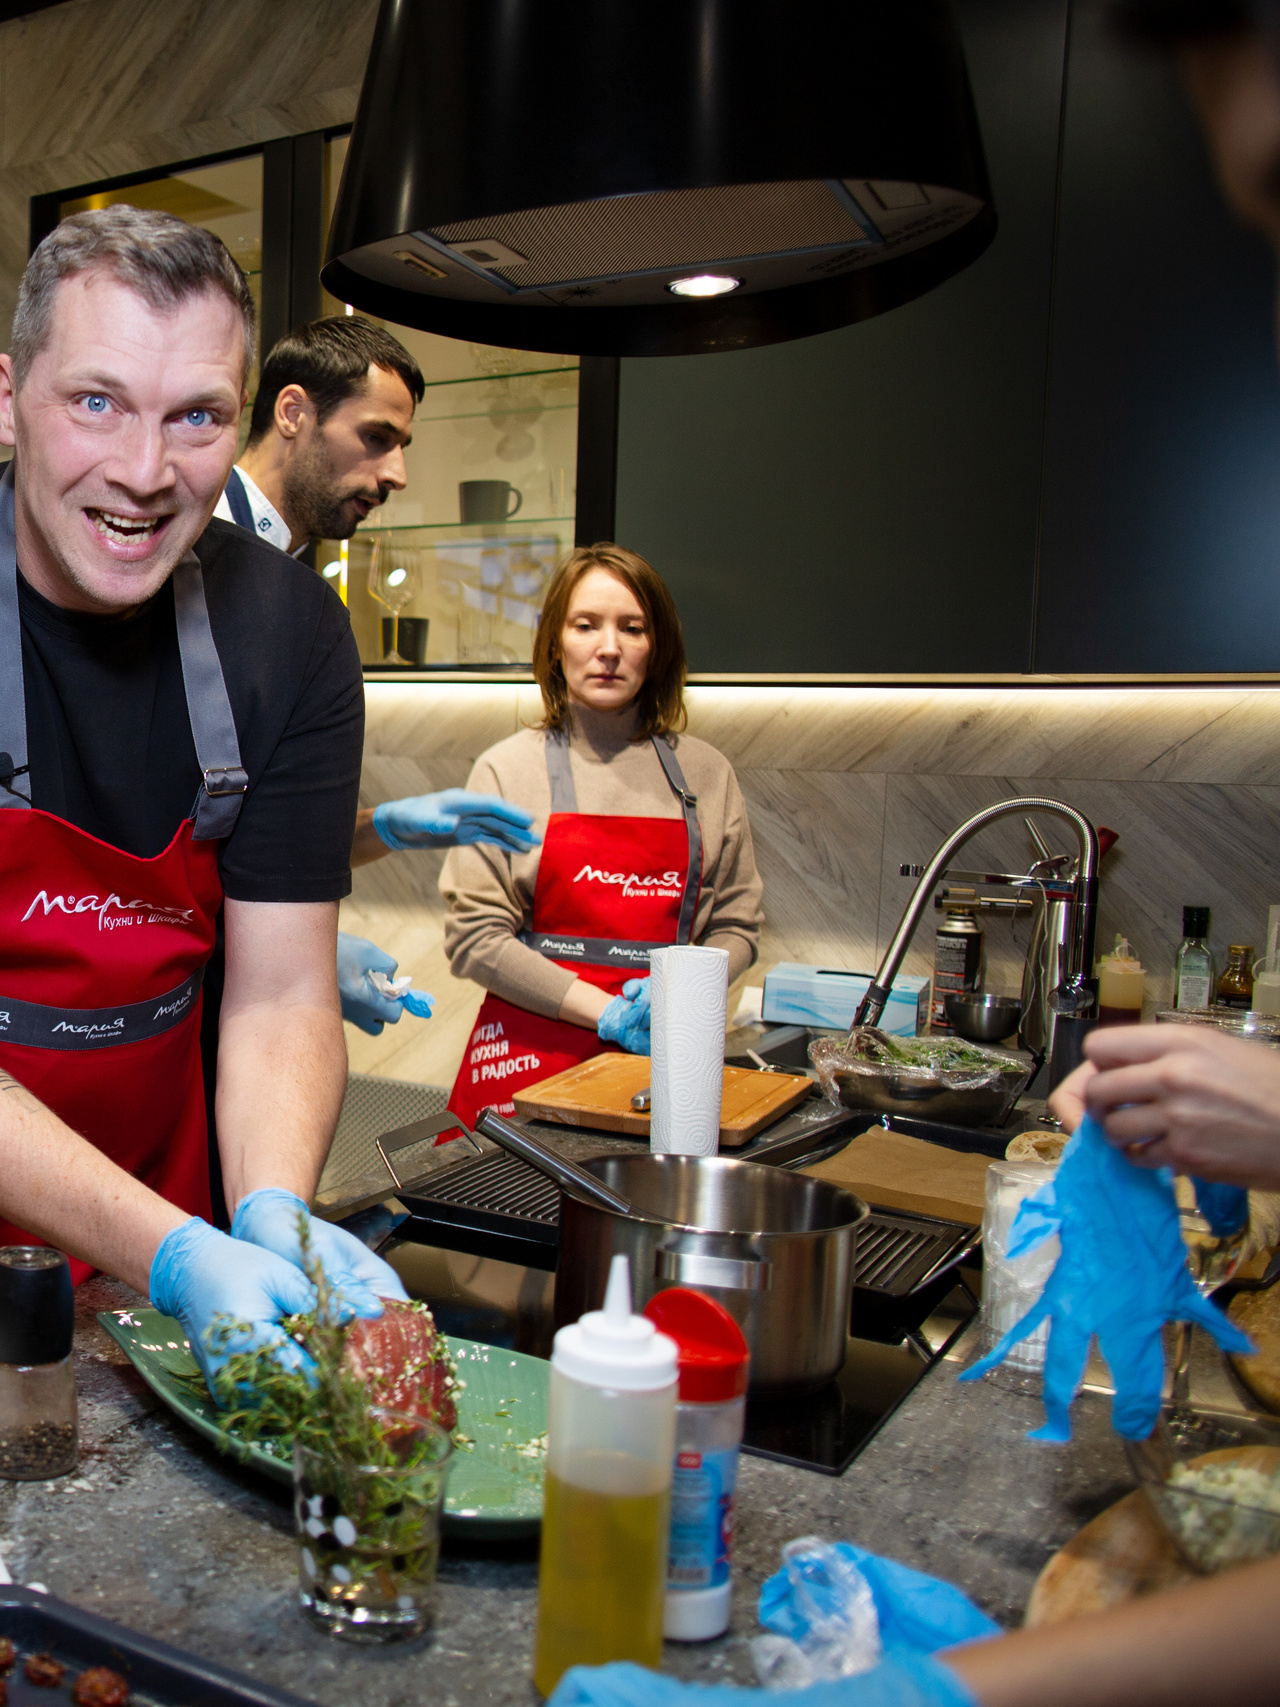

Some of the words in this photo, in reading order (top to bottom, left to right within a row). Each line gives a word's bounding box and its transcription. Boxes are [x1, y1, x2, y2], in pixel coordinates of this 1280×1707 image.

[573, 865, 682, 897] Мария
[21, 890, 193, 931] Мария
[104, 916, 133, 930] Кухни
[136, 915, 143, 925] и
[147, 913, 188, 925] Шкафы
[52, 1017, 125, 1039] Мария
[472, 1068, 479, 1085] В
[481, 1053, 540, 1080] РАДОСТЬ
